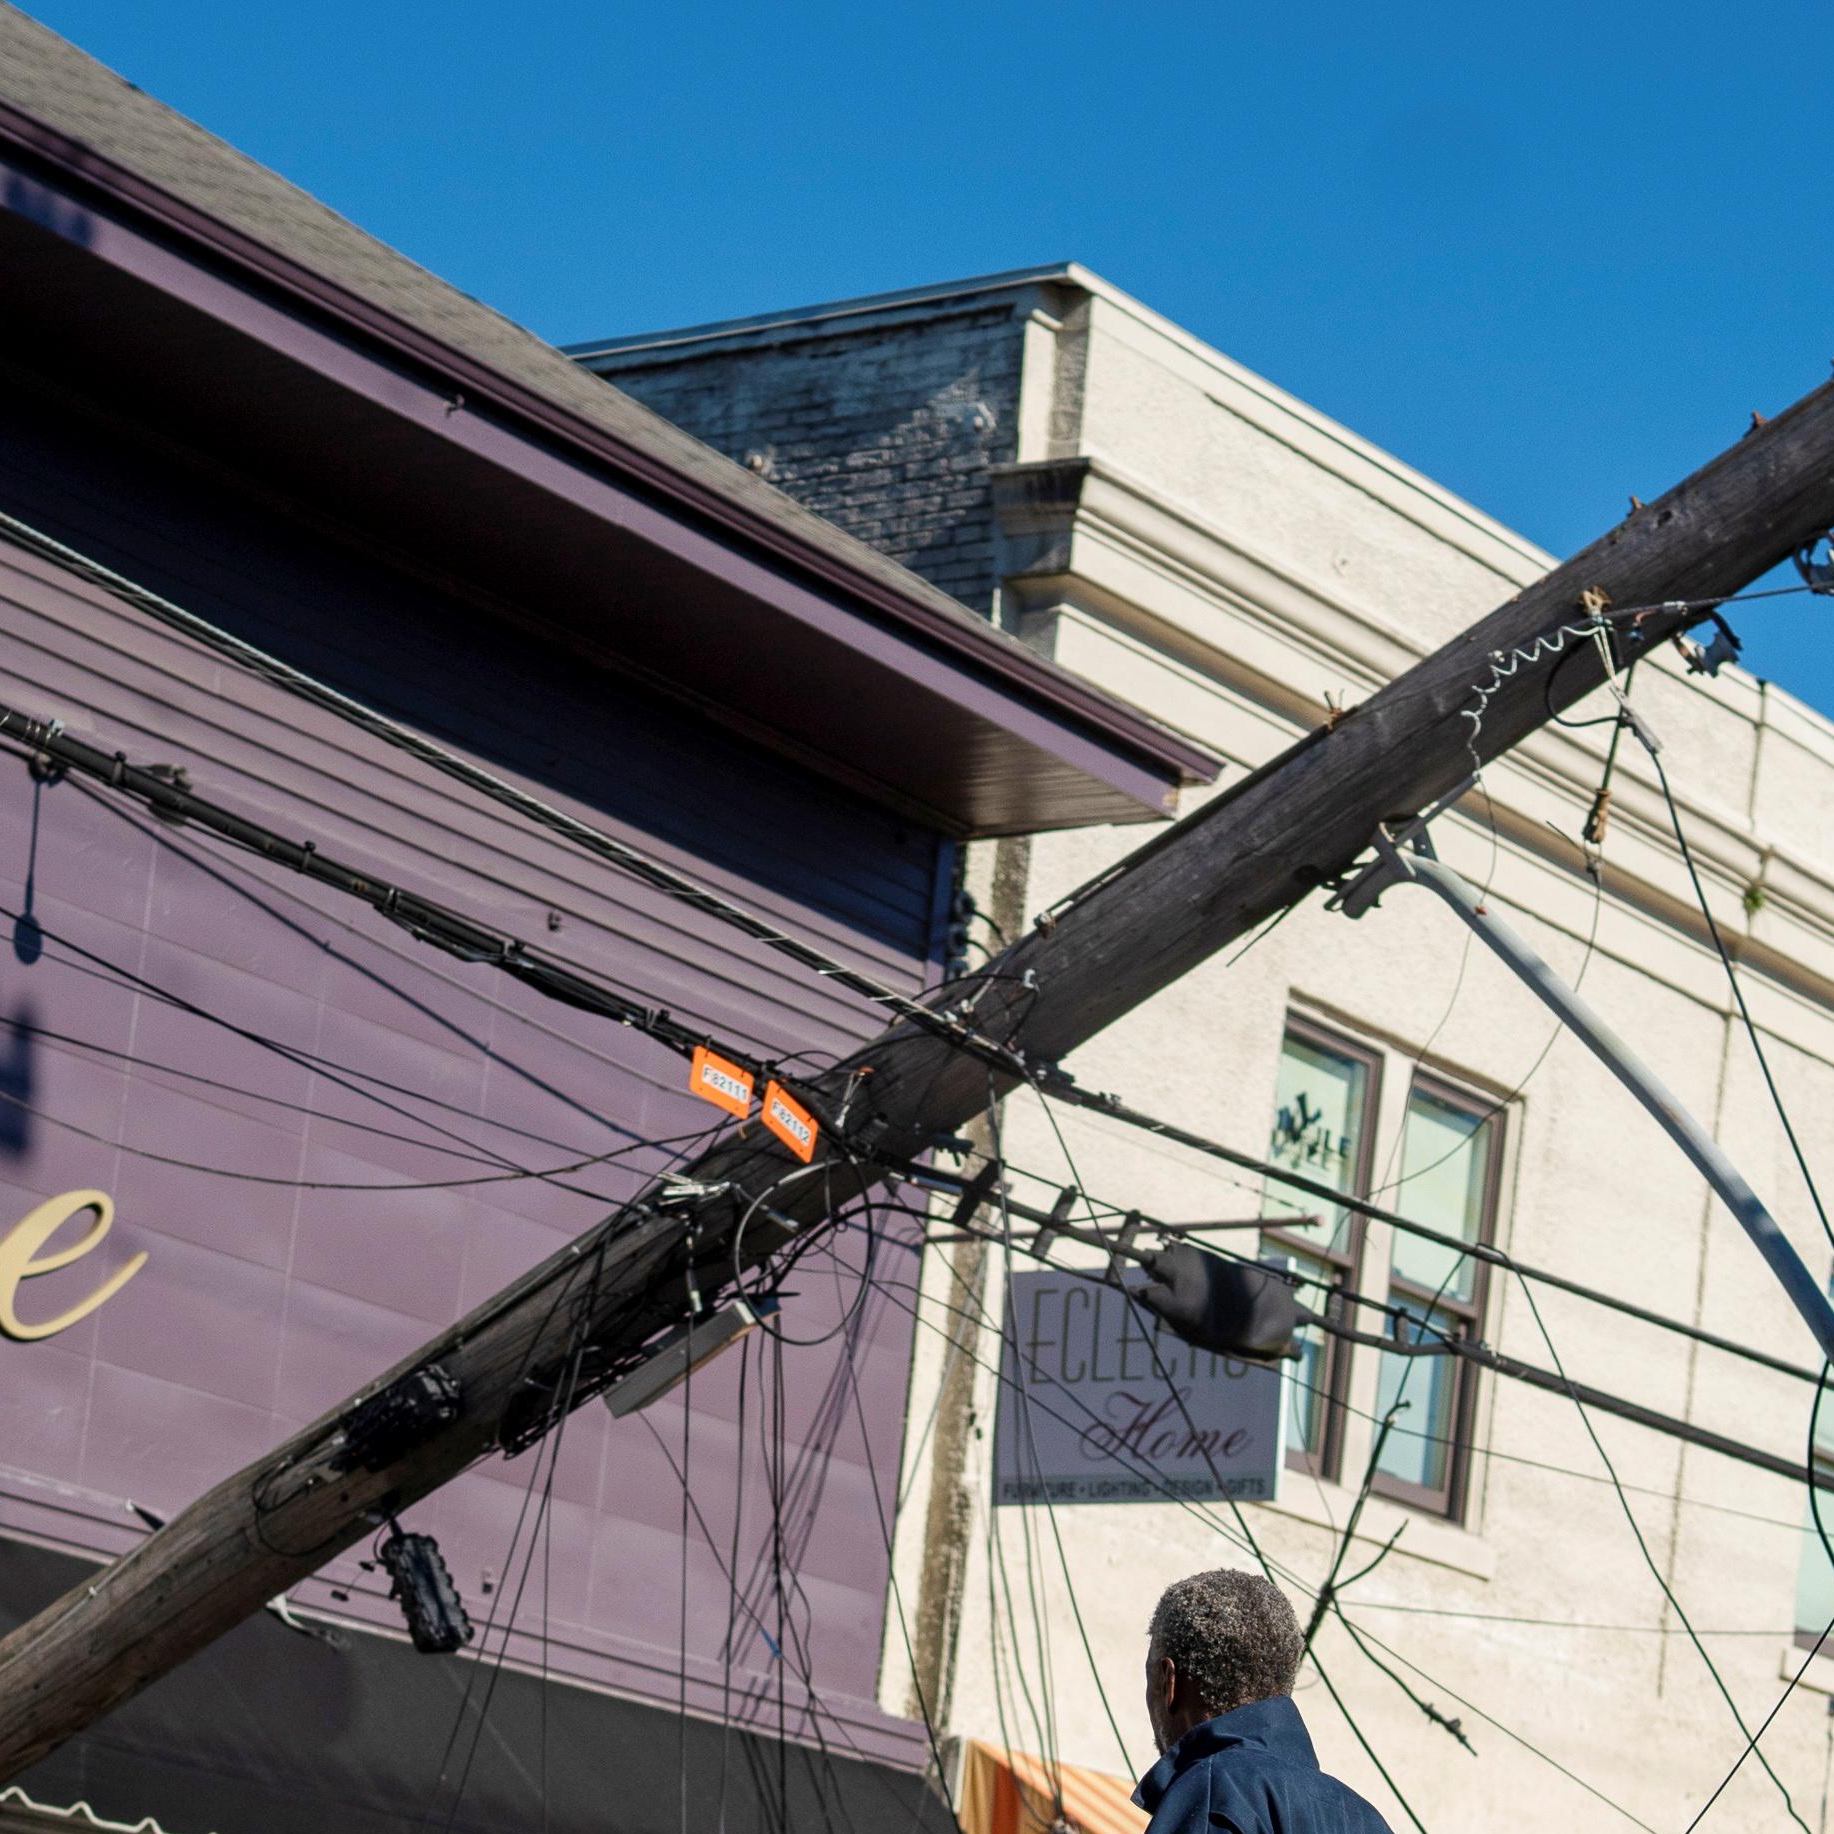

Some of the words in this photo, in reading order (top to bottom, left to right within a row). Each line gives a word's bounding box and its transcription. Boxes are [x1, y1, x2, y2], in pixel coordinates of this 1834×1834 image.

[702, 1066, 748, 1102] F82111
[771, 1100, 811, 1145] F82112
[1078, 1385, 1254, 1461] Home
